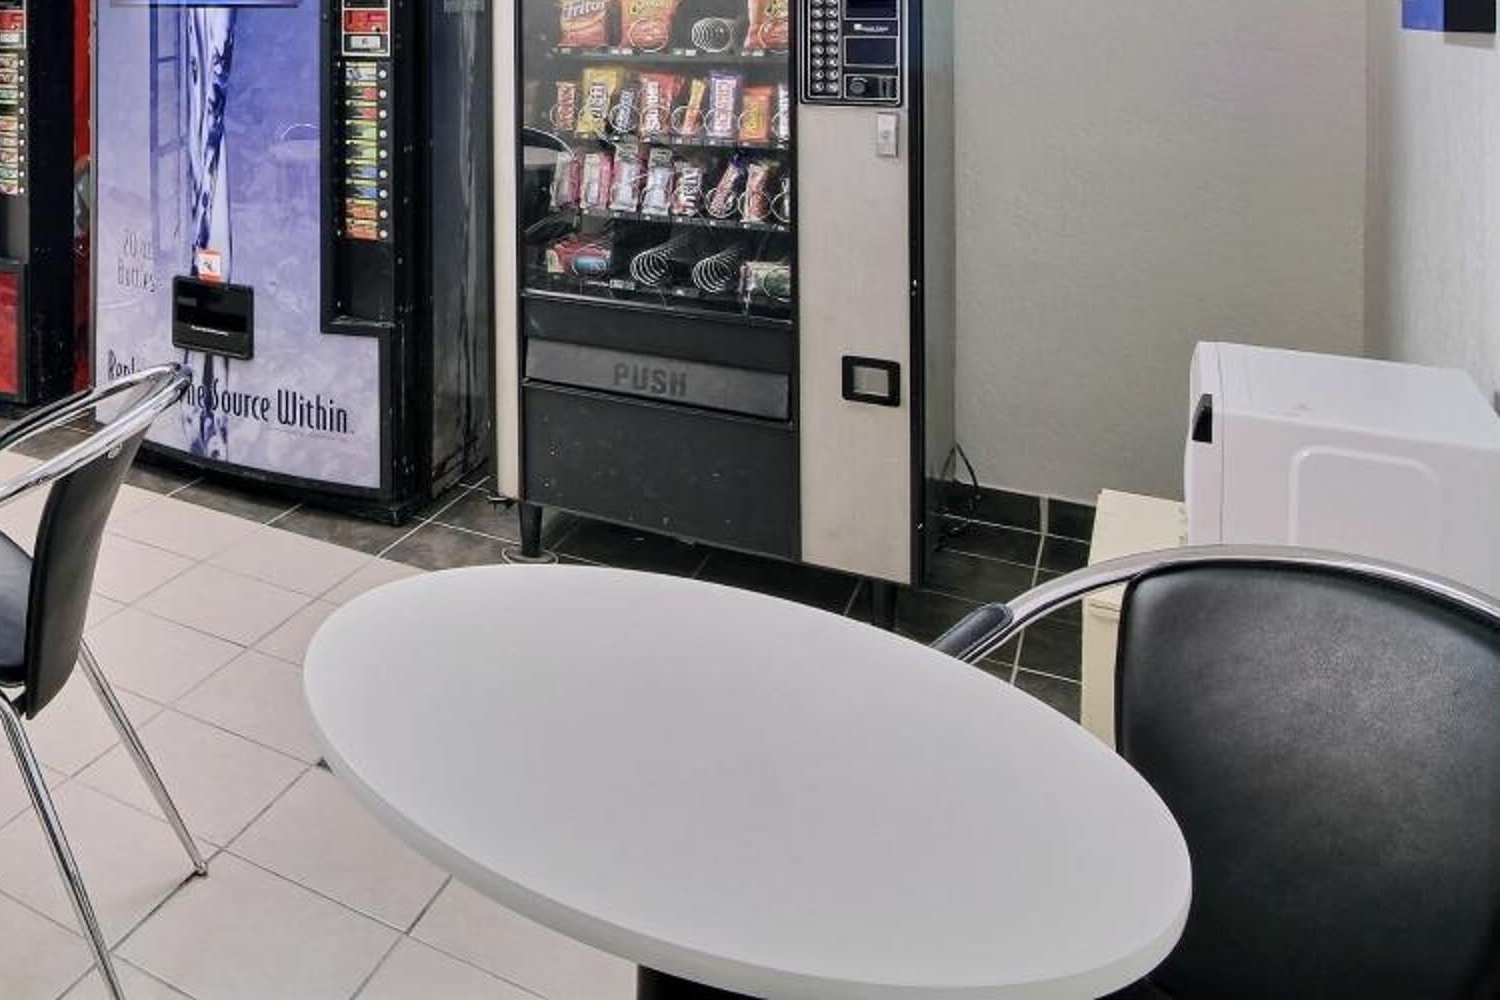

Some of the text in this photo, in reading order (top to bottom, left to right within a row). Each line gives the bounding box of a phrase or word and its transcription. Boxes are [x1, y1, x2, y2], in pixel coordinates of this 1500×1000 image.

[614, 362, 687, 398] PUSH
[211, 378, 271, 423] Source
[277, 388, 348, 434] Within
